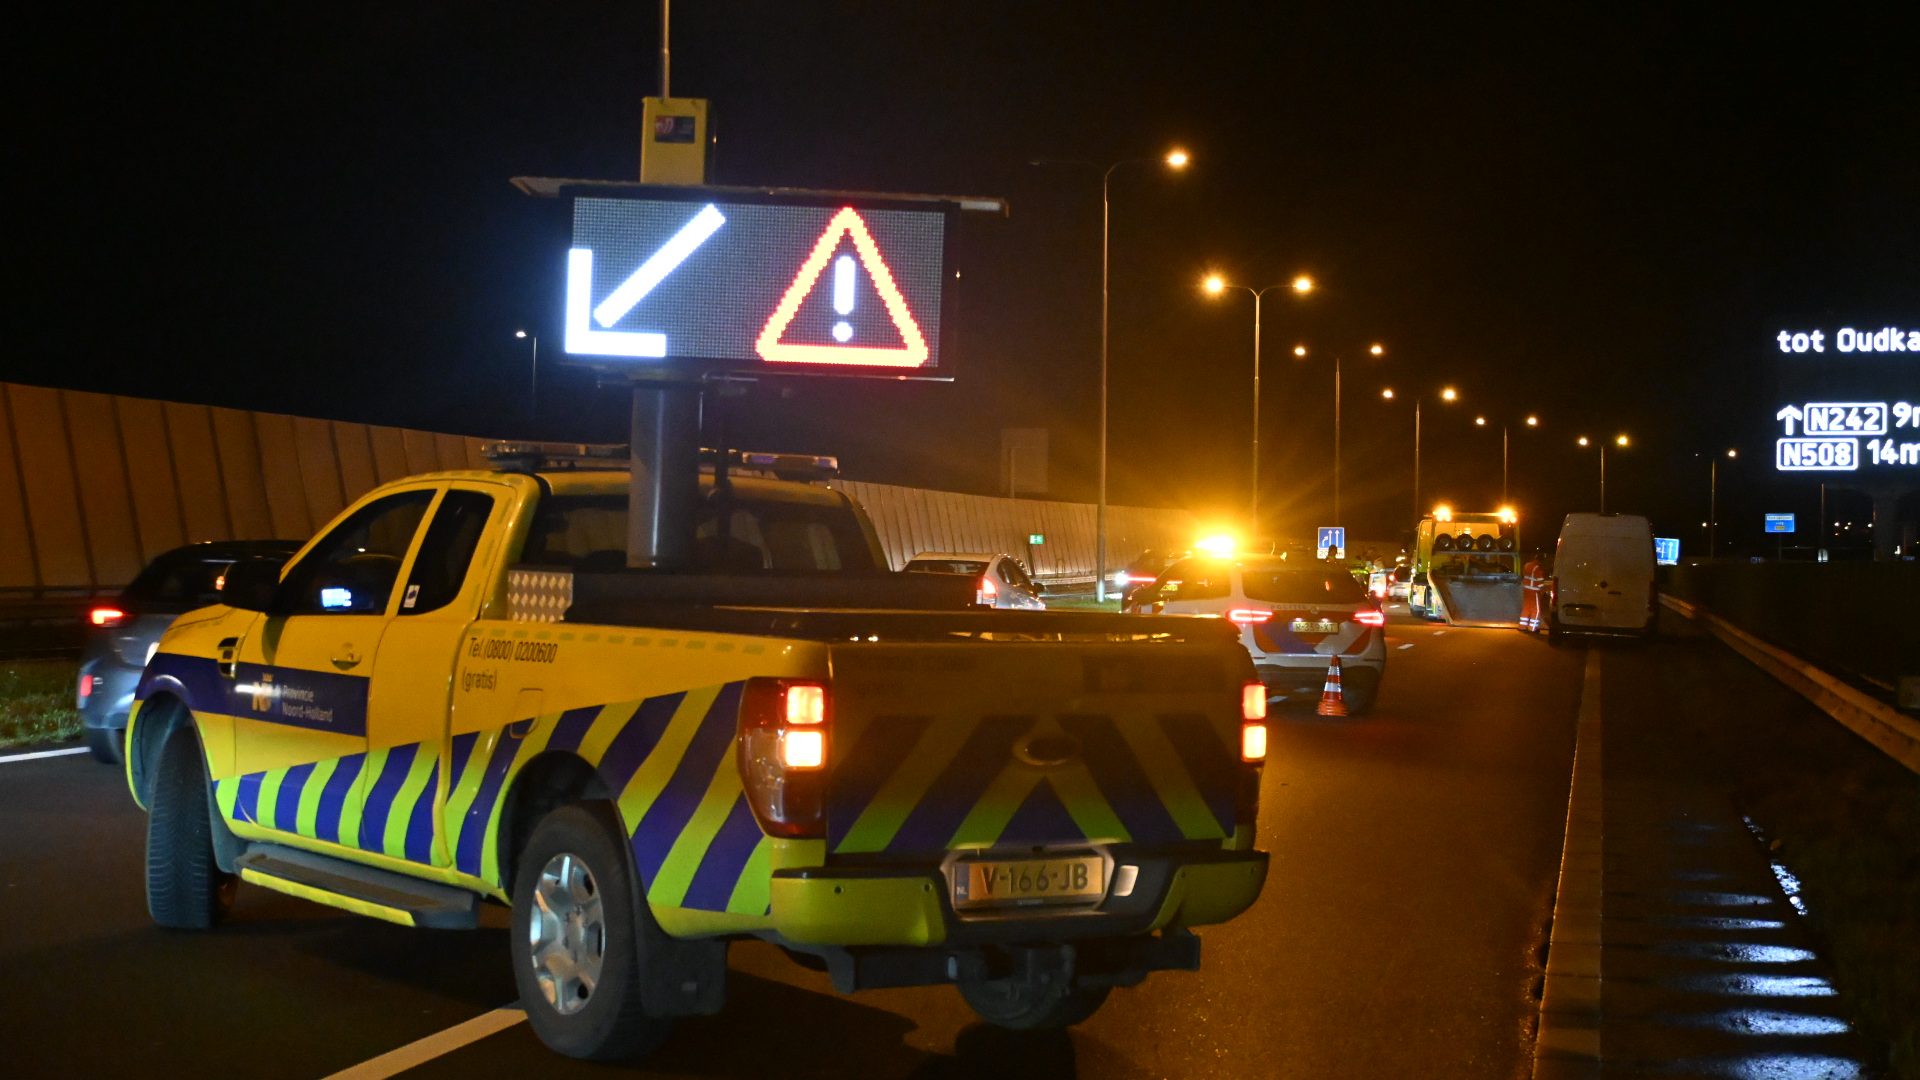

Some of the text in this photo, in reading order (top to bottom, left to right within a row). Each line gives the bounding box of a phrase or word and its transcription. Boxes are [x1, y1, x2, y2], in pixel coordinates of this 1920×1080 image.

[1777, 327, 1920, 352] tot Oudka
[1810, 407, 1880, 431] N242
[1783, 443, 1851, 466] N508
[515, 641, 558, 664] 0200600
[462, 666, 497, 692] (gratis)
[981, 863, 1089, 894] V-166-JB
